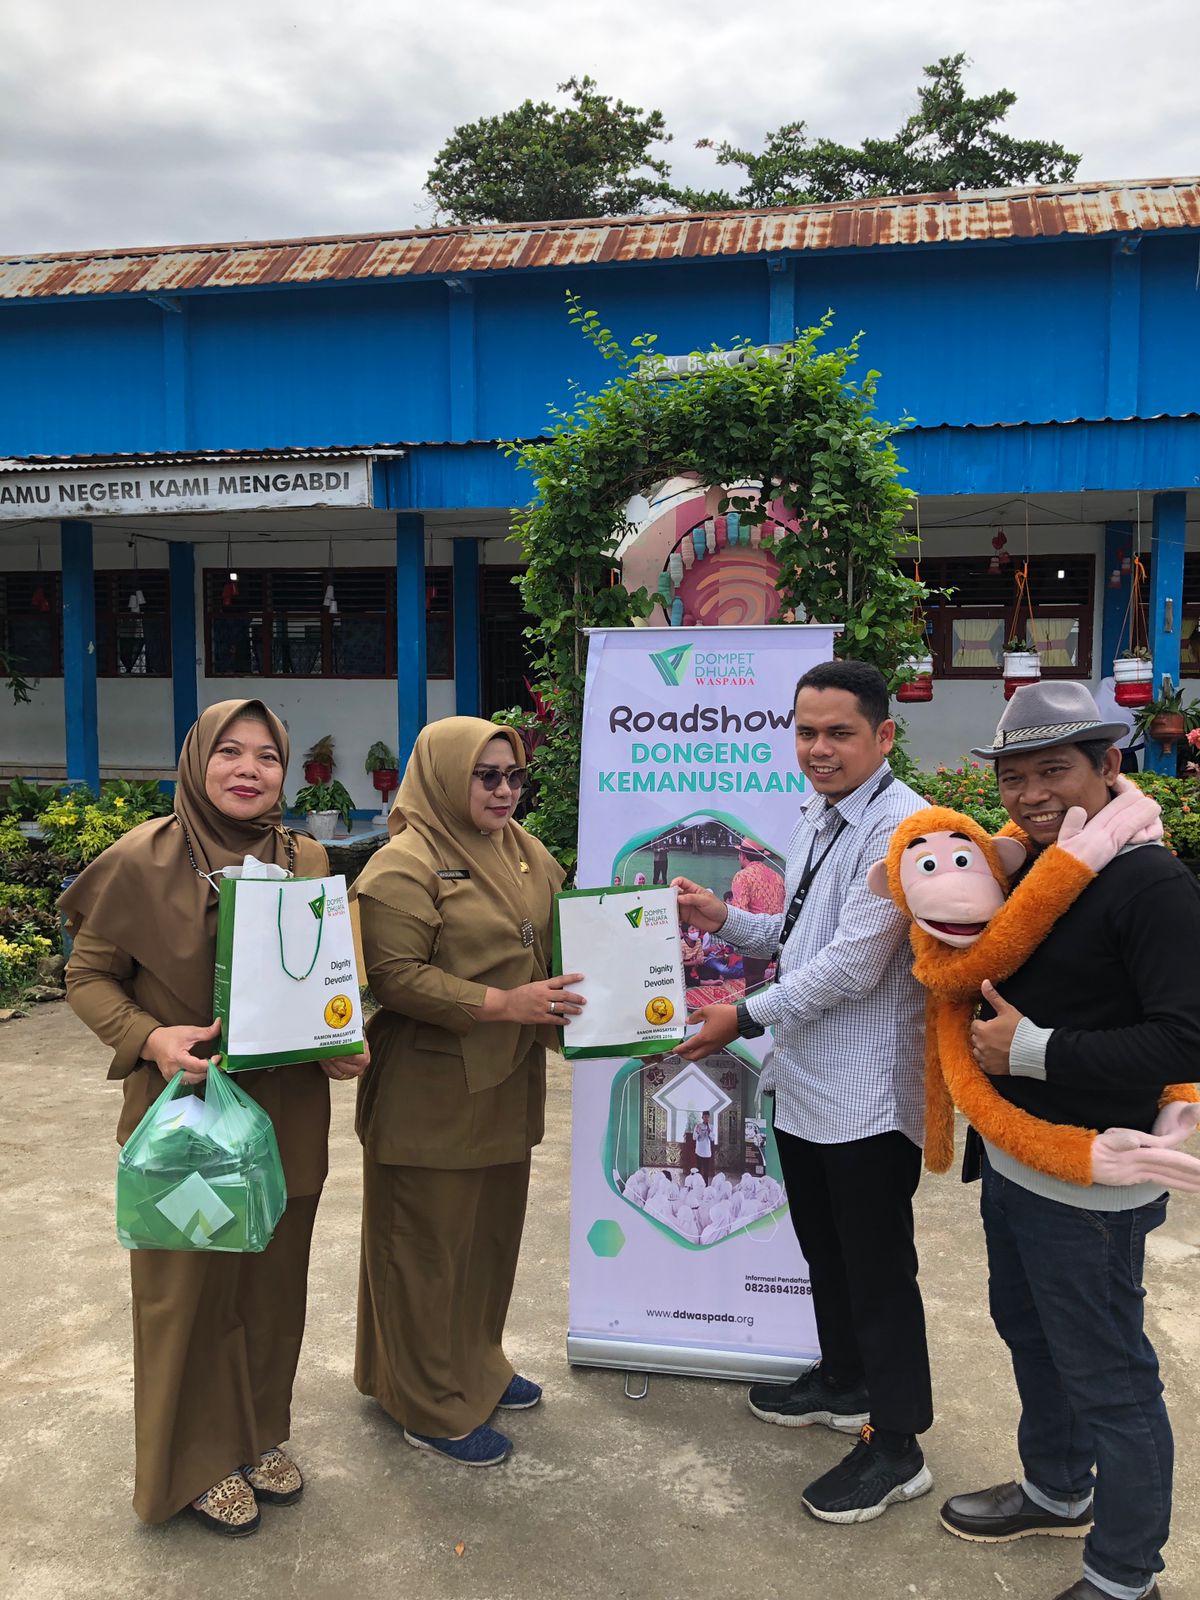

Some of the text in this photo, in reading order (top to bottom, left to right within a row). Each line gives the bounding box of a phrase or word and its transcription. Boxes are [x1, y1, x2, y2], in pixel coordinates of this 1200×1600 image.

[0, 471, 350, 504] AMU NEGERI KAMI MENGABDI
[695, 653, 755, 665] DOMPET
[695, 666, 755, 677] DHUAFA
[695, 677, 755, 686] WASPADA
[631, 743, 772, 764] DONGENG
[599, 771, 805, 793] KEMANUSIAAN
[330, 960, 351, 970] Dignity
[649, 964, 673, 974] Dignity
[324, 974, 353, 986] Devotion
[644, 978, 675, 988] Devotion
[745, 1275, 777, 1283] Informasi
[646, 1309, 754, 1327] www.ddwaspada.org
